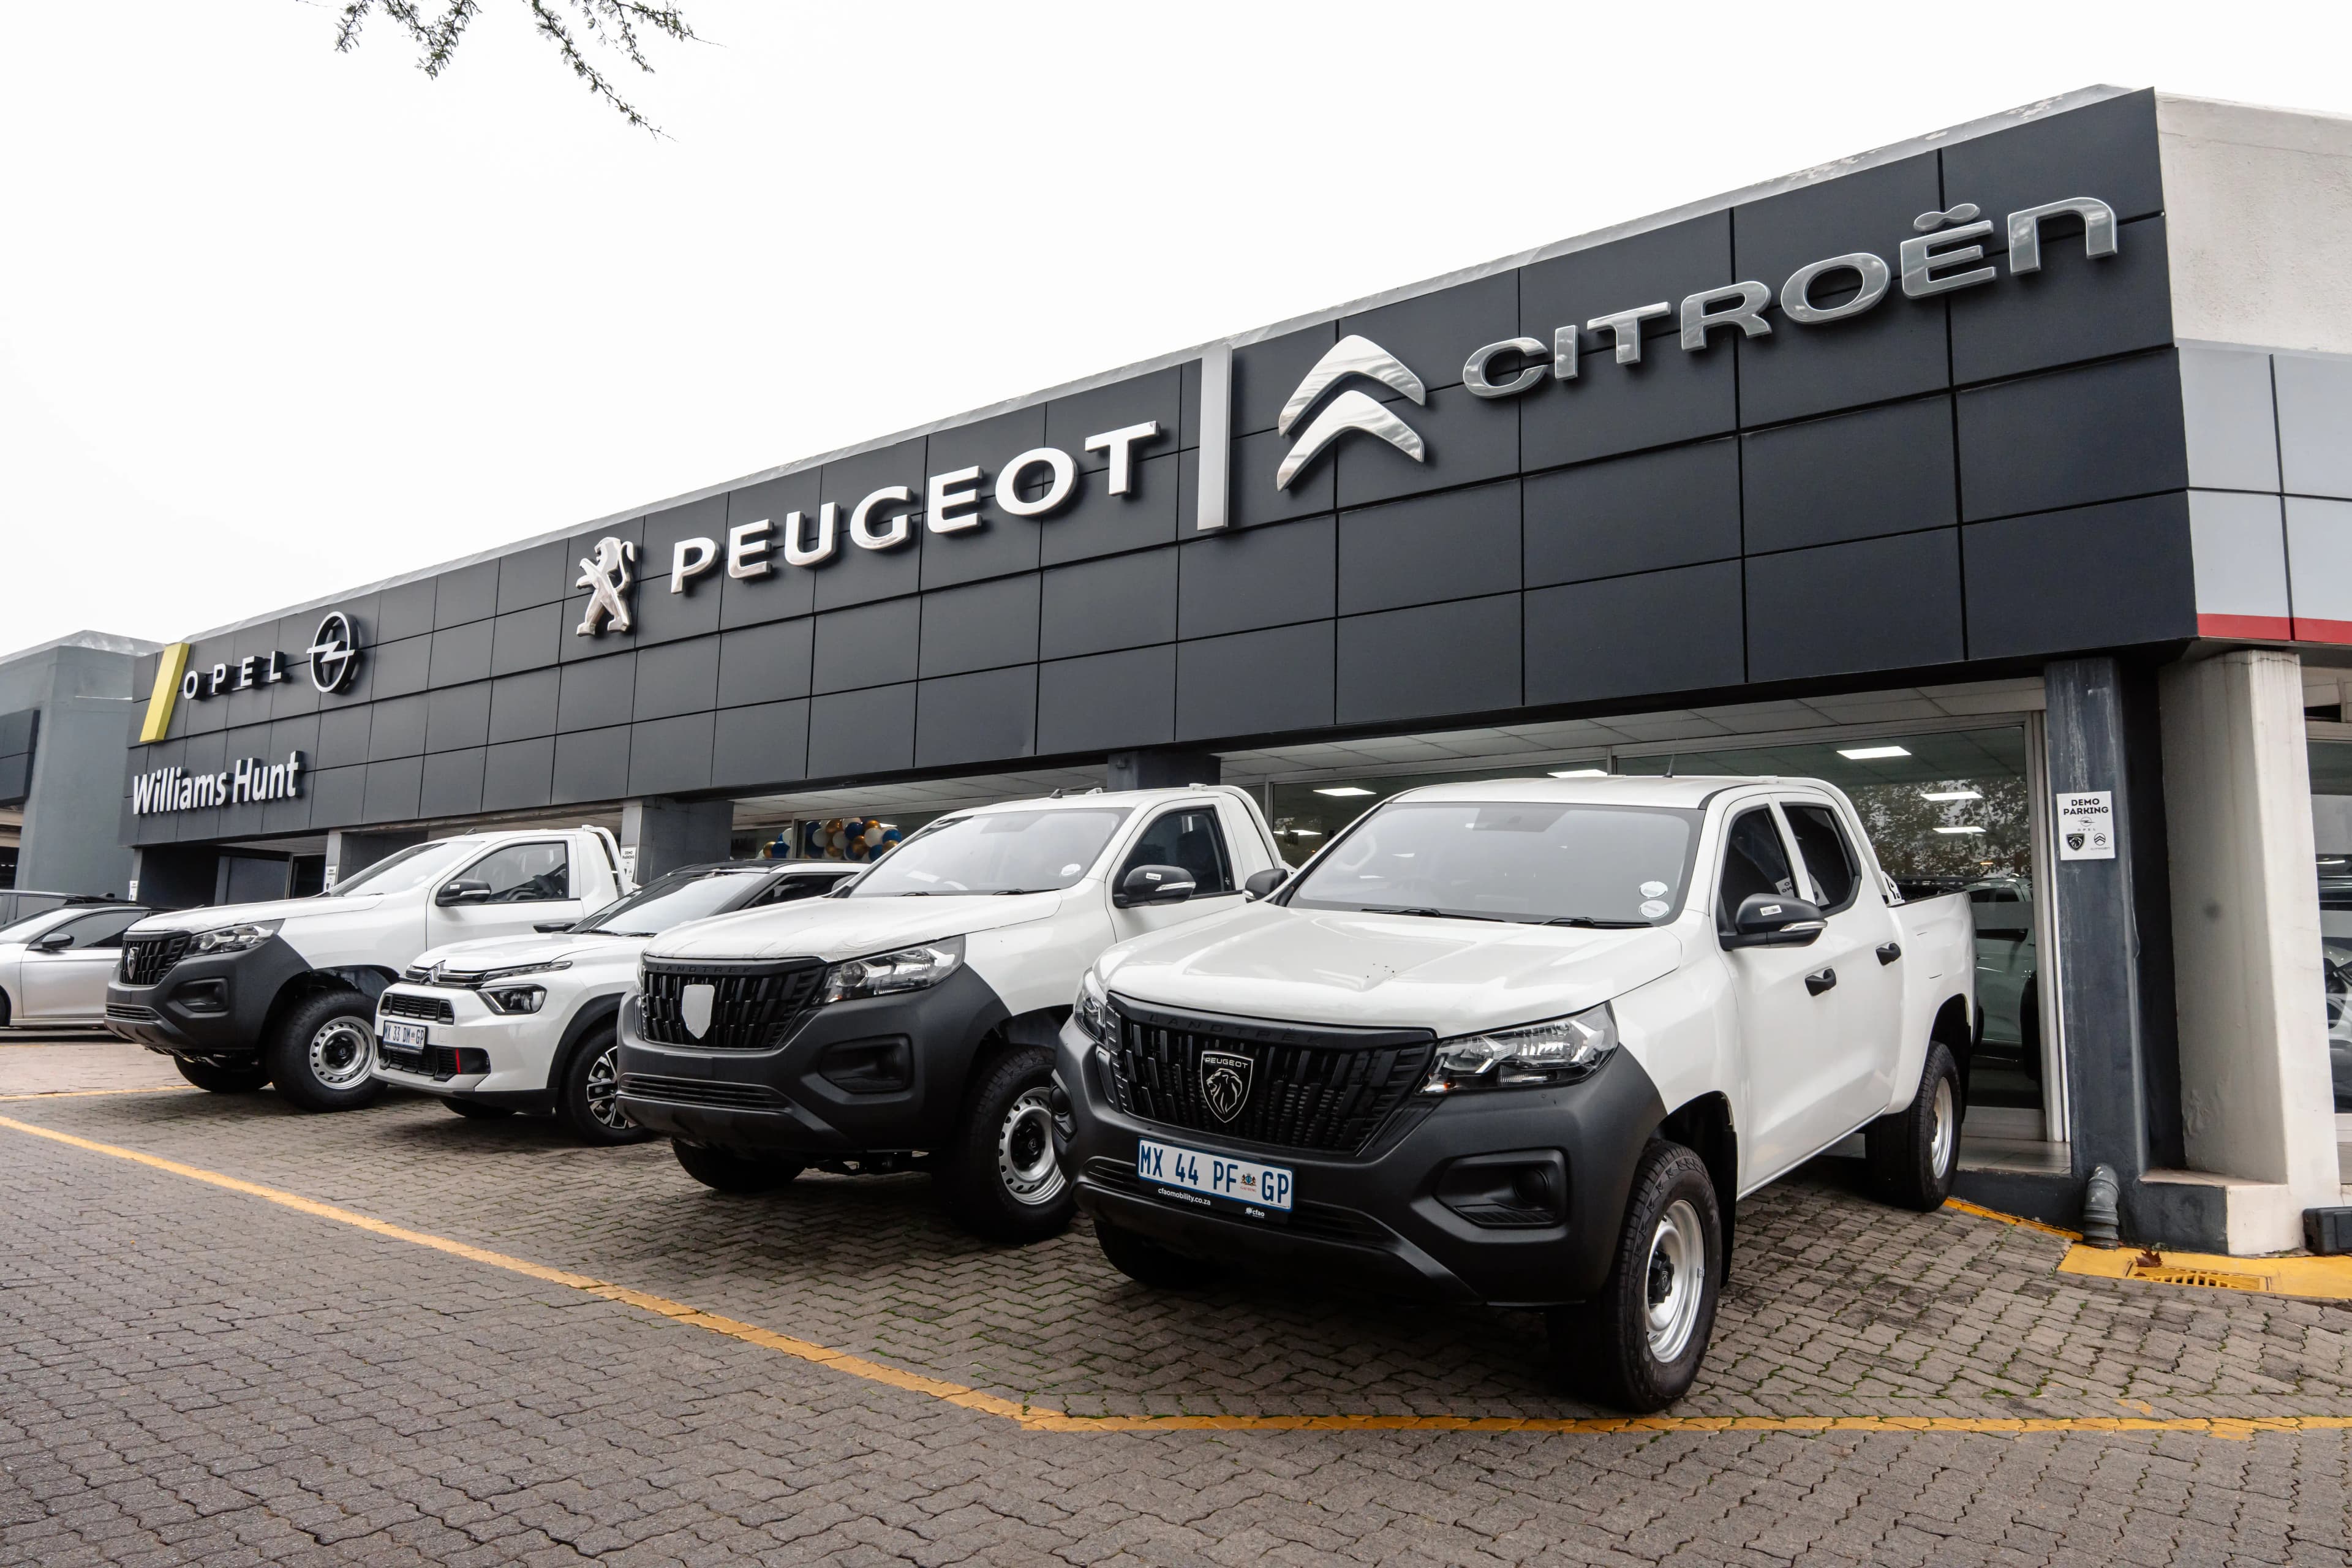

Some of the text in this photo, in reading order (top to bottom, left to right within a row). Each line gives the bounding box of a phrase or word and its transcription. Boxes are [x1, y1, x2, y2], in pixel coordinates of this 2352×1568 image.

[670, 420, 1160, 595] PEUGEOT
[183, 650, 285, 700] OPEL
[133, 750, 300, 815] Williams Hunt
[2063, 807, 2109, 815] PARKING
[655, 965, 753, 974] LANDTREK
[384, 1024, 424, 1044] MX 33 DM GP
[1148, 1014, 1323, 1044] LANDTREK
[1205, 1057, 1248, 1068] PEUGEOT
[1140, 1145, 1289, 1204] MX 44 PF GP
[1158, 1188, 1211, 1205] cfaomobility.co.za
